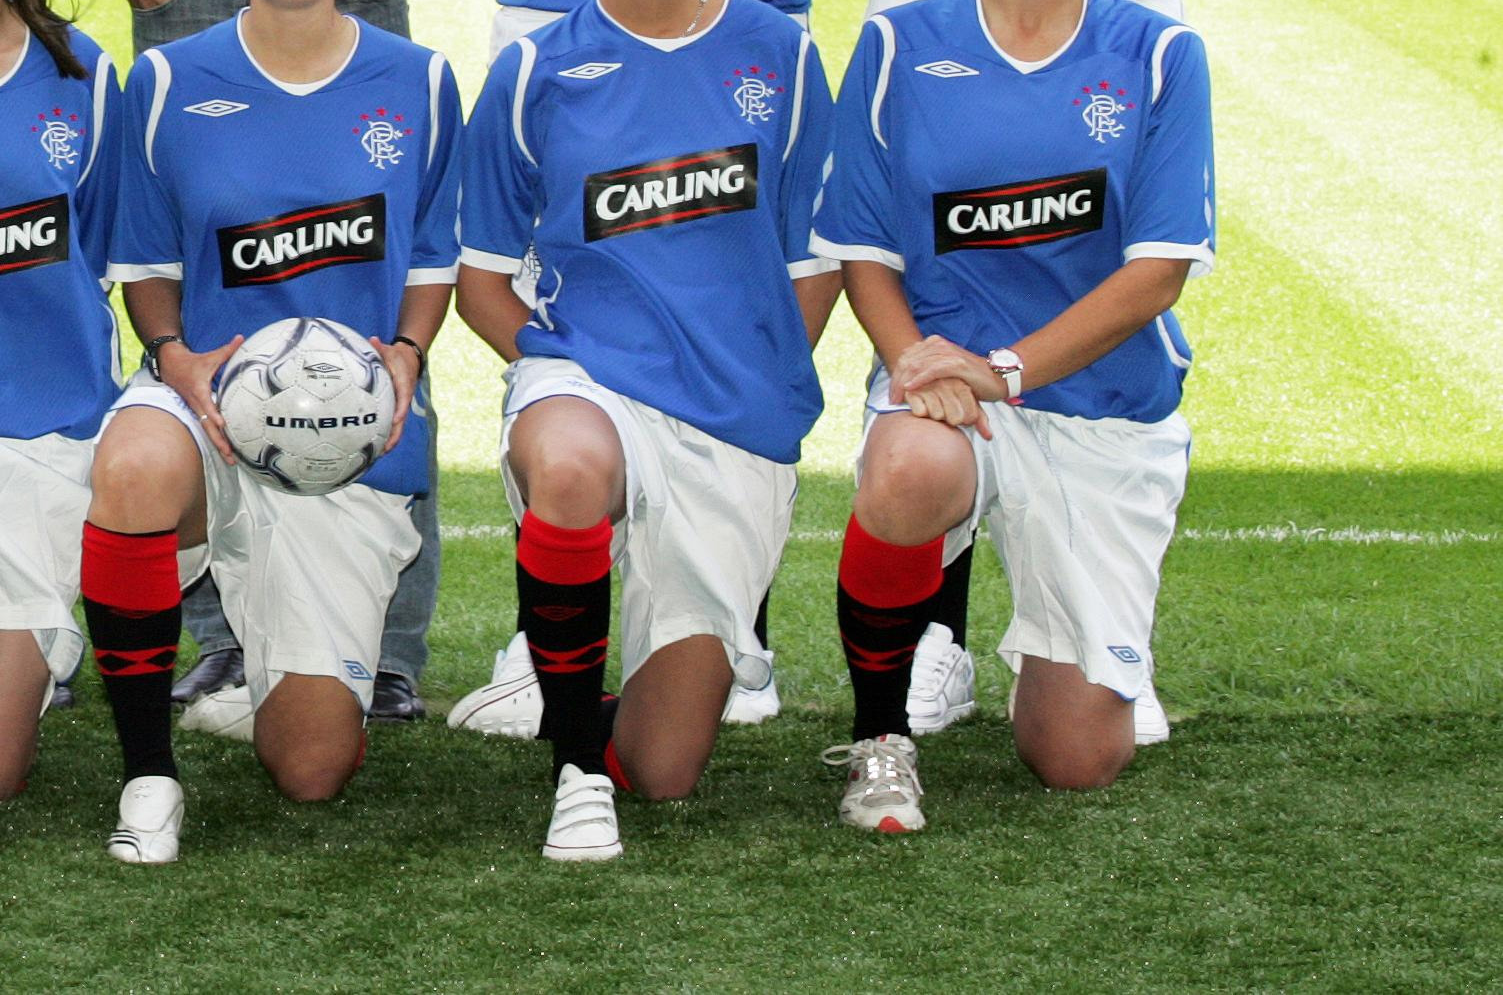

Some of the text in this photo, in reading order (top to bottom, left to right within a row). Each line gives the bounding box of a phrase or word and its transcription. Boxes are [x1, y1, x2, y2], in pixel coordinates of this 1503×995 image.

[595, 164, 745, 221] CARLING
[948, 189, 1092, 234] CARLING
[232, 215, 374, 270] CARLING
